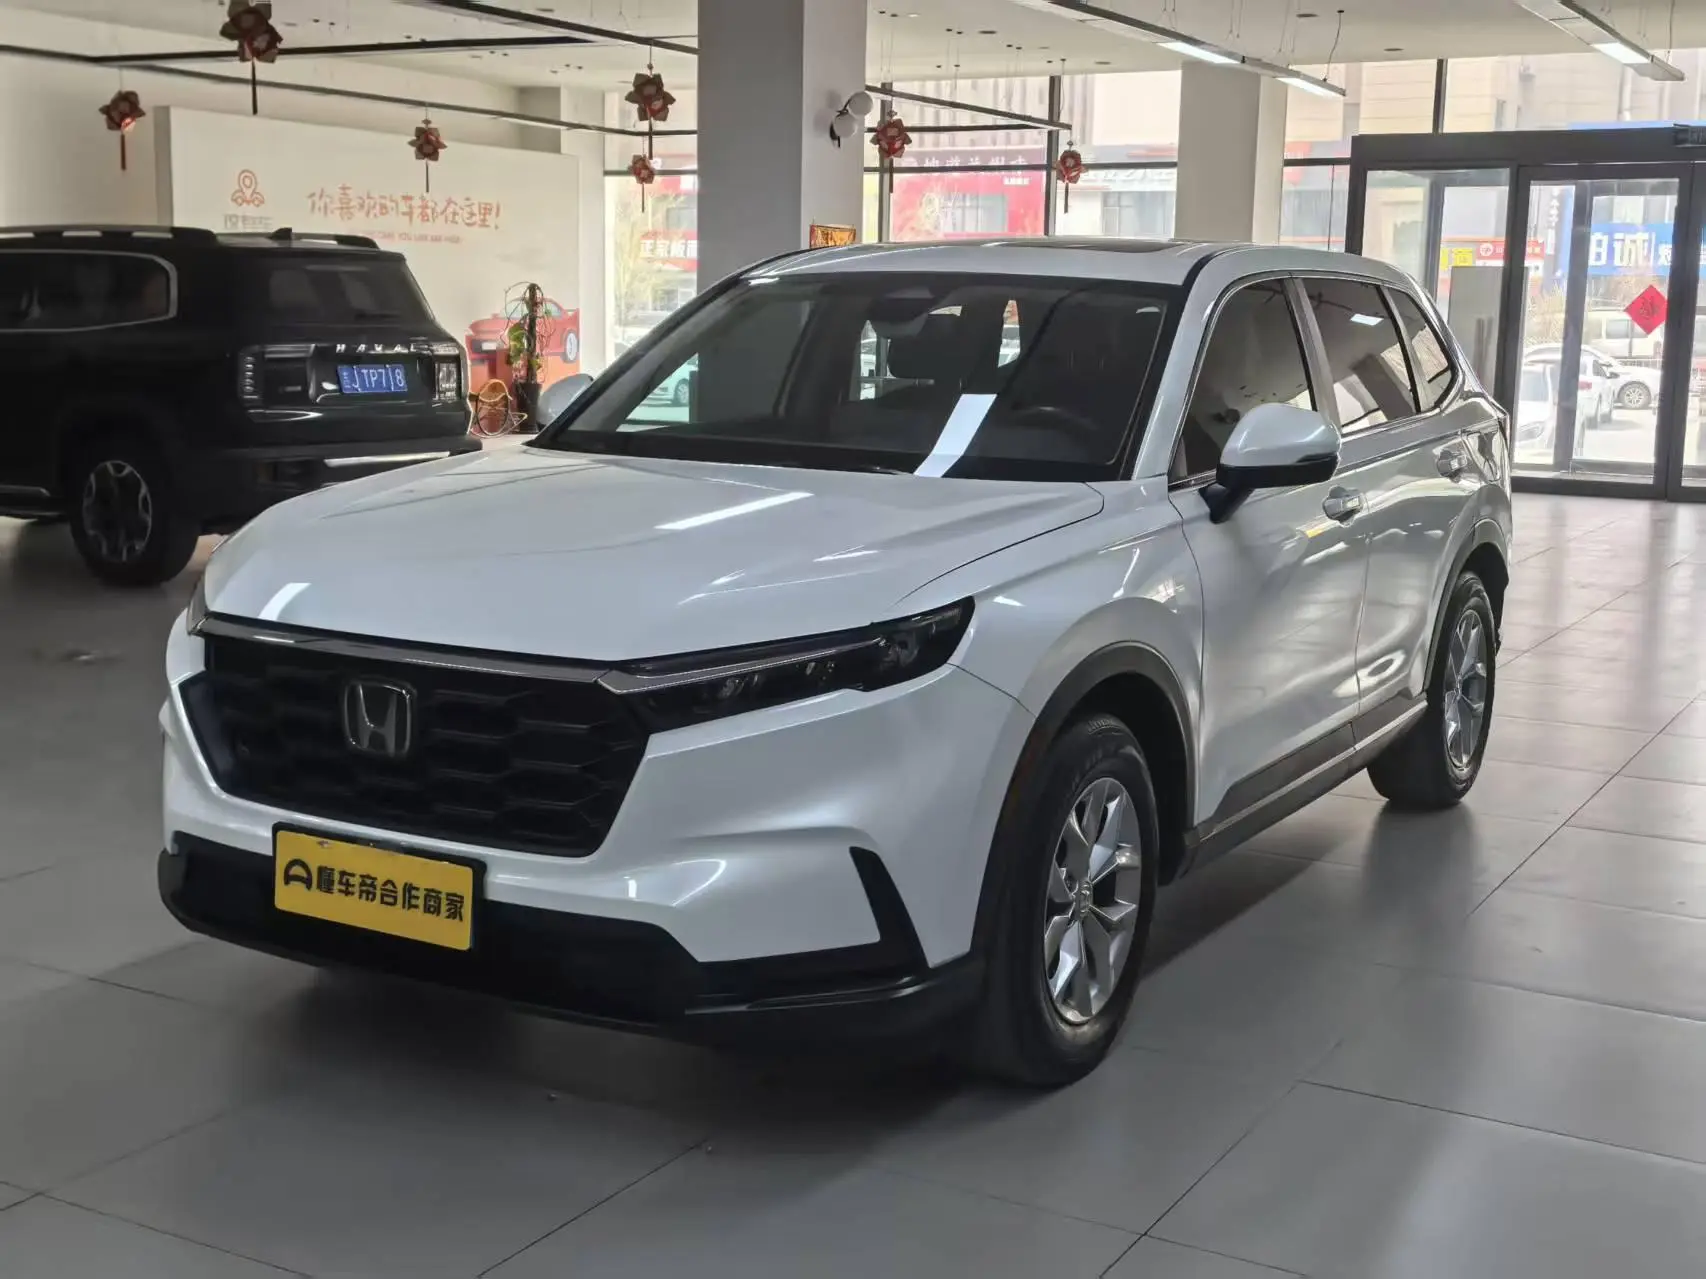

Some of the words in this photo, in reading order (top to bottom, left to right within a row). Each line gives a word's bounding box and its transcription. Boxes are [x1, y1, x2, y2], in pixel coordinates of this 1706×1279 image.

[335, 343, 417, 353] HAVAL
[316, 865, 465, 922] 懂车帝合作商家
